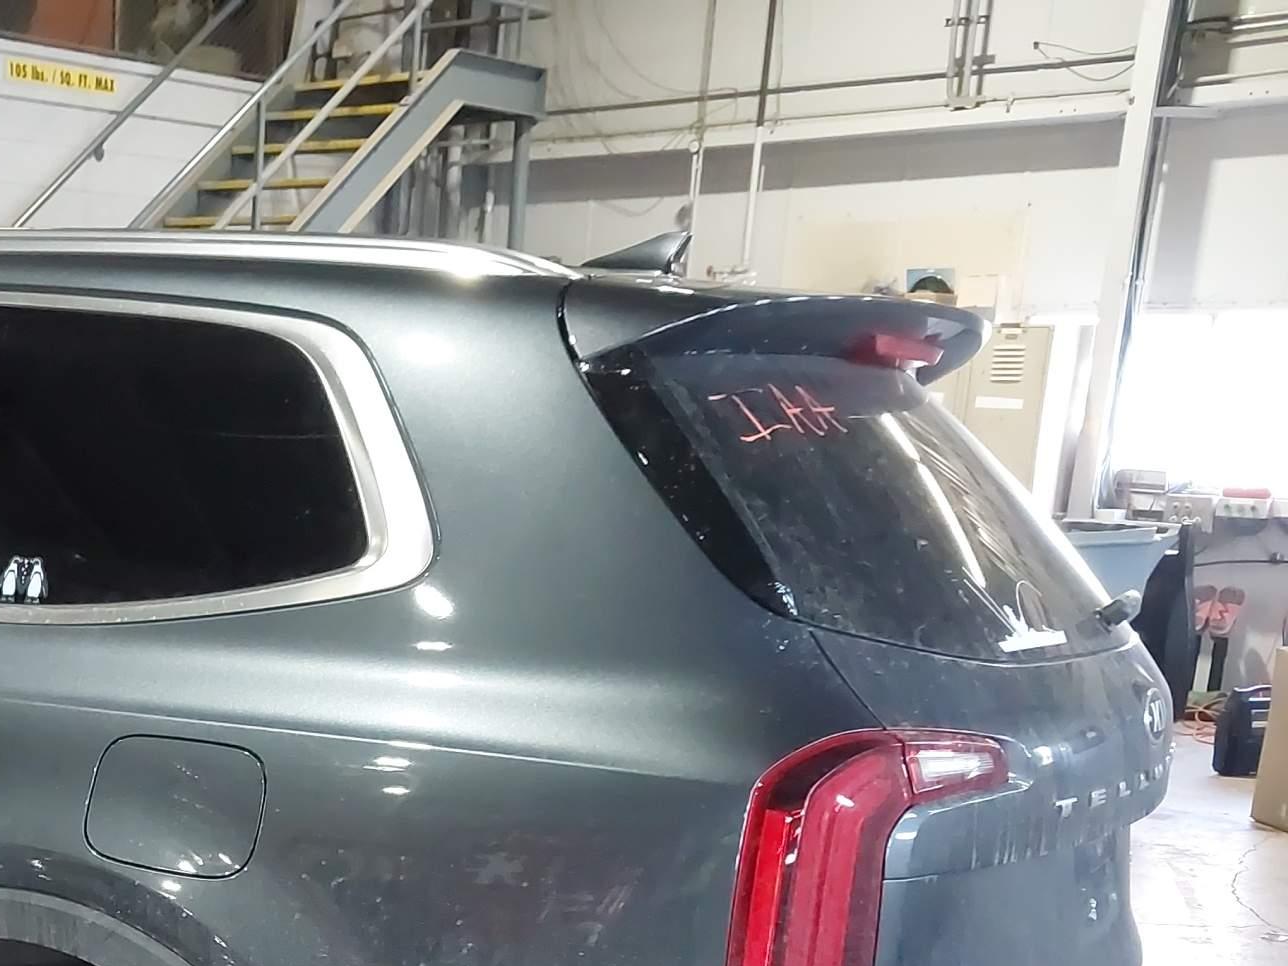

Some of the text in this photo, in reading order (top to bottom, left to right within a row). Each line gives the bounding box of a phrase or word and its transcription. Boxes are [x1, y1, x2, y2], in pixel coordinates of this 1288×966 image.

[9, 61, 28, 79] 105
[31, 65, 49, 82] lbs.
[60, 70, 75, 86] SQ.
[78, 74, 92, 88] FT.
[94, 76, 115, 92] MAX
[708, 383, 848, 442] IAA
